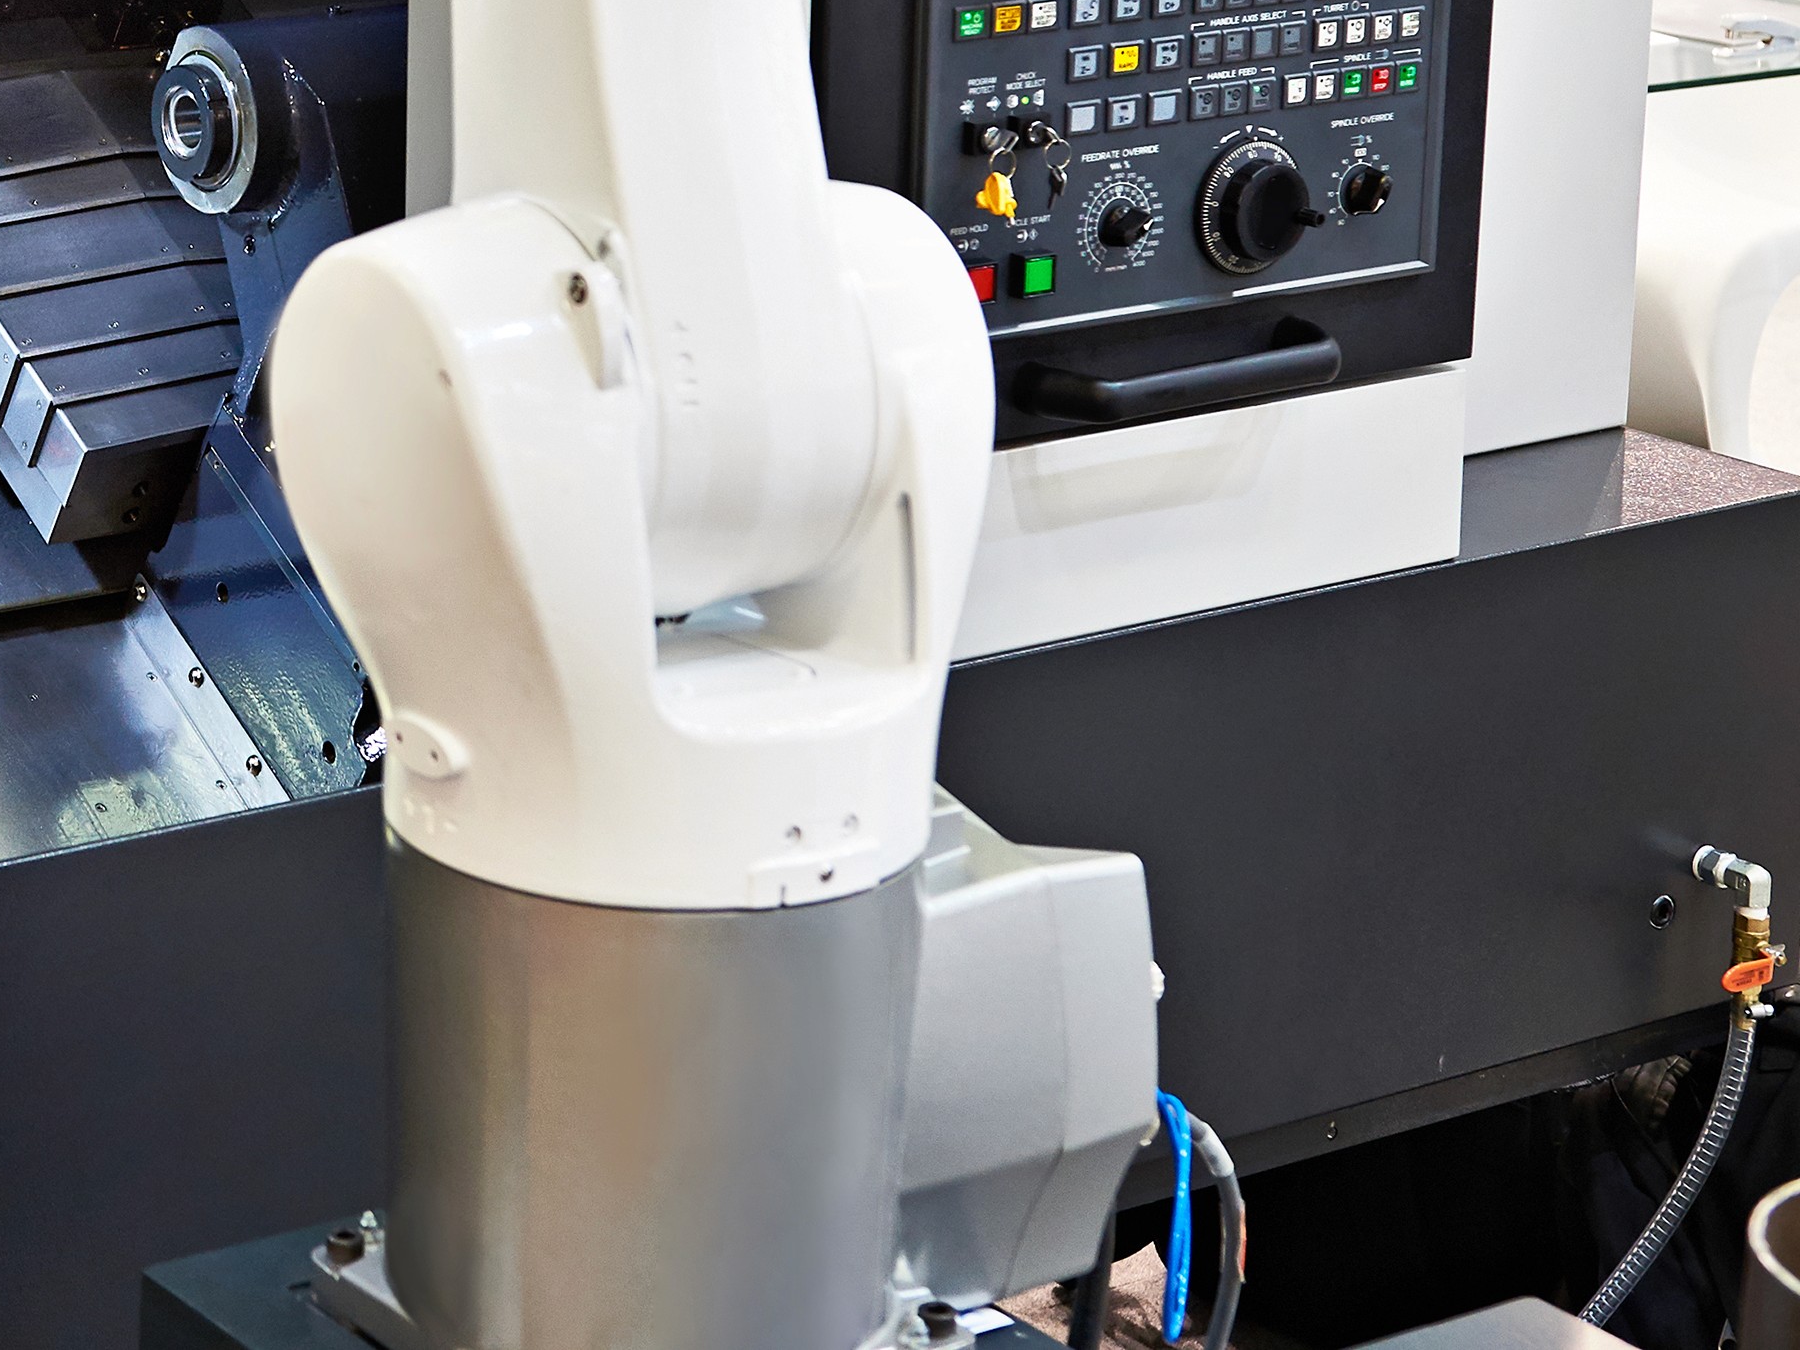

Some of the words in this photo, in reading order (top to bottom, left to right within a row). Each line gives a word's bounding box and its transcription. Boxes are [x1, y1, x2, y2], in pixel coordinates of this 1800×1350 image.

[1323, 2, 1349, 12] TURRET
[1210, 16, 1240, 26] HANDLE
[1242, 14, 1259, 22] AXIS
[1260, 10, 1287, 21] SELECT
[1344, 52, 1372, 62] SPINDLE
[1207, 70, 1237, 80] HANDLE
[1238, 67, 1258, 76] FEED
[968, 76, 998, 86] PROGRAM
[1006, 82, 1023, 90] MODE
[1024, 78, 1046, 88] SELECT
[968, 85, 996, 94] PROTECT
[1330, 117, 1358, 128] SPINDLE
[1360, 112, 1394, 124] OVERRIDE
[1081, 150, 1120, 162] FEEDRATE
[1122, 144, 1160, 157] OVERRIDE
[1006, 218, 1028, 228] CCLE
[1030, 214, 1051, 225] START
[950, 226, 968, 236] FEED
[969, 224, 989, 233] HOLD
